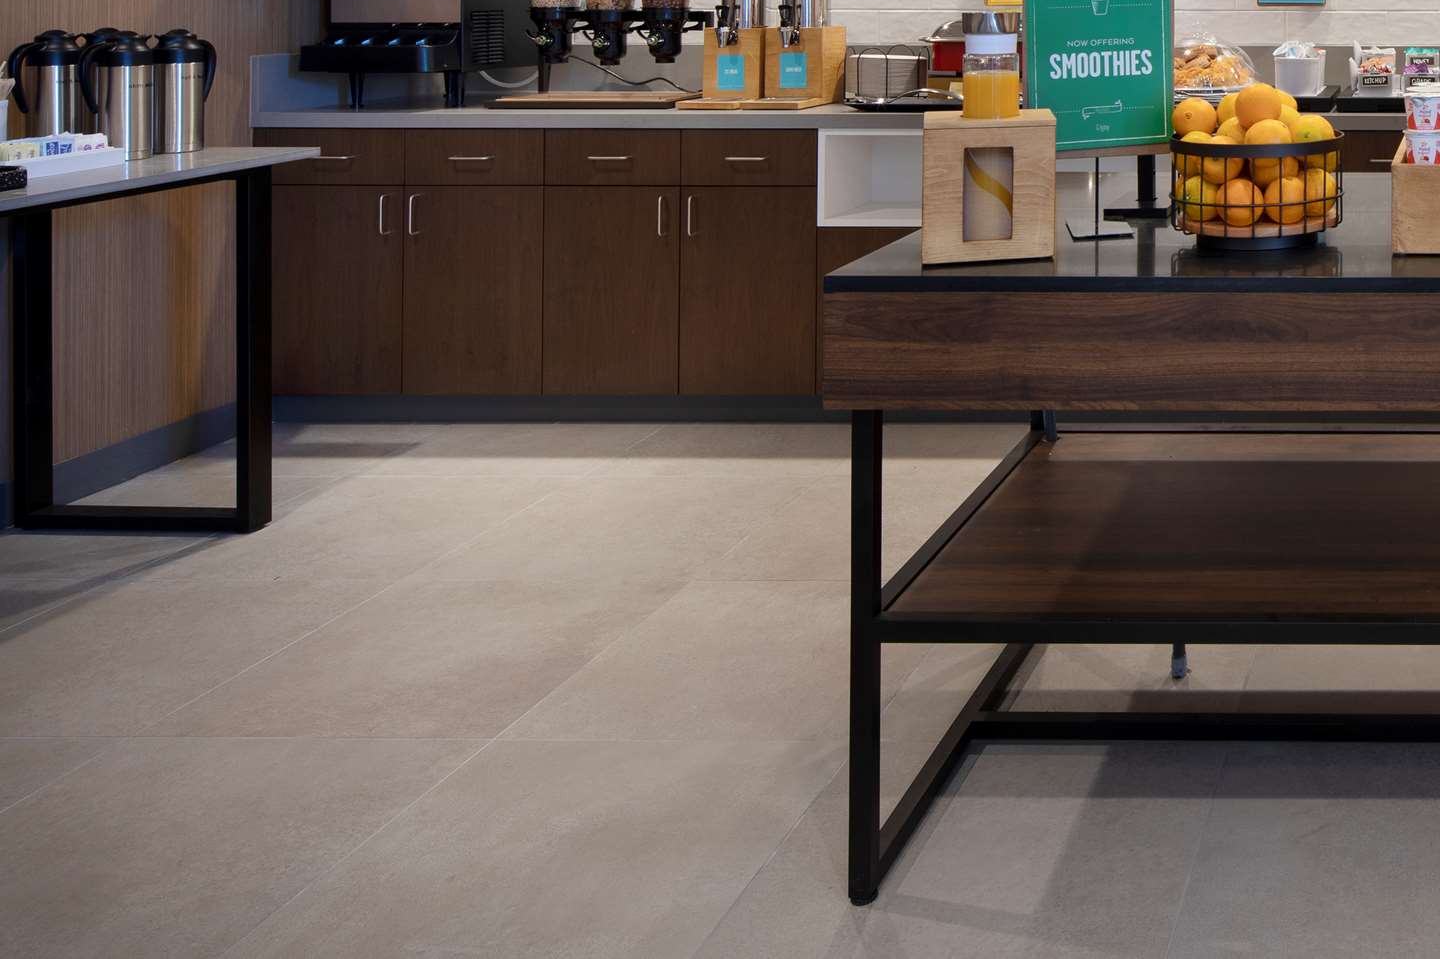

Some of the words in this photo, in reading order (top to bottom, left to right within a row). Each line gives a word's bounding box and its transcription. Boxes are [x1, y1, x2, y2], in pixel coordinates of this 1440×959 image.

[1066, 40, 1088, 48] NOW
[1090, 38, 1134, 46] OFFERING
[1050, 49, 1152, 80] SMOOTHIES
